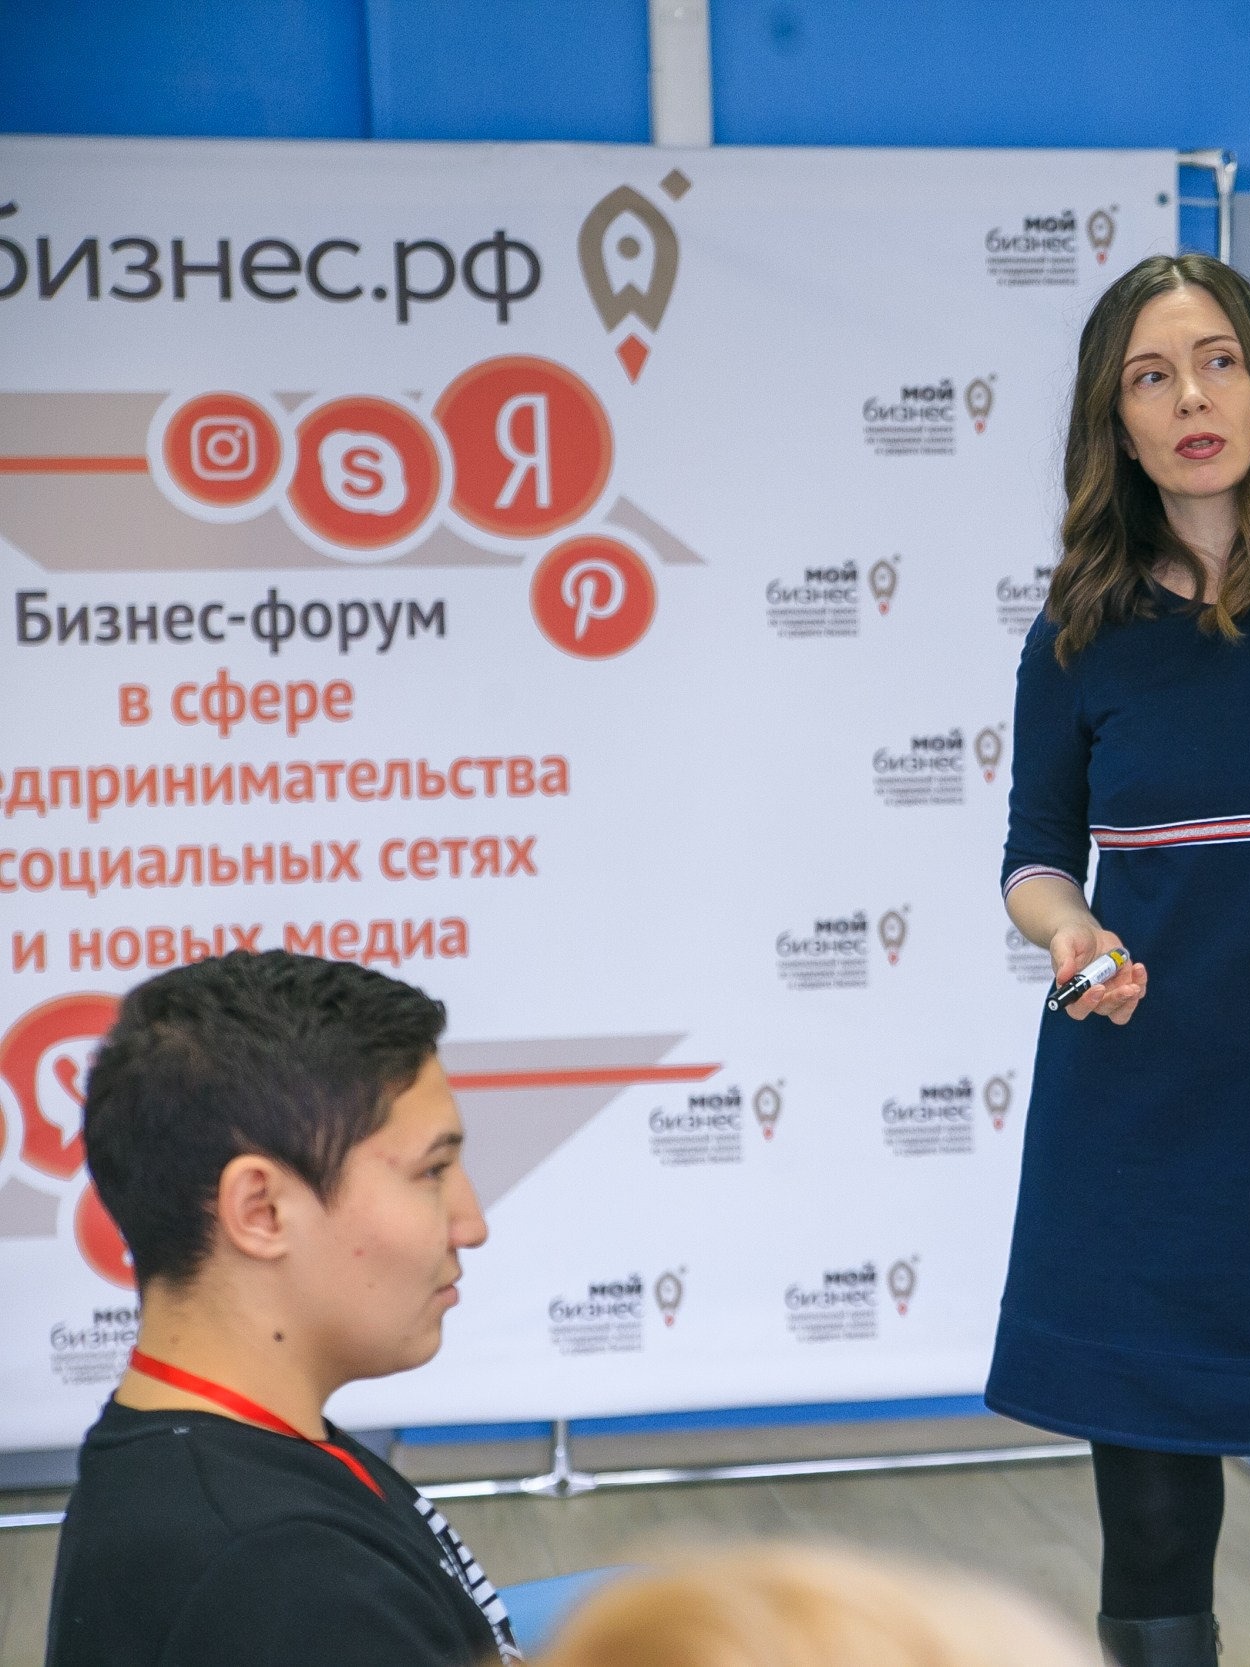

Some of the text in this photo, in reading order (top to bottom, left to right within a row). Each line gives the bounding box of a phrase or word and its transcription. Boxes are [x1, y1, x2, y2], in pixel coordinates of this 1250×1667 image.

[15, 587, 446, 655] Бизнес-форум
[119, 668, 355, 738] в сфере
[0, 755, 570, 822] дпринимательства
[379, 836, 538, 880] сетях
[12, 931, 47, 973] и
[283, 917, 469, 967] медиа
[50, 1322, 137, 1351] бизне
